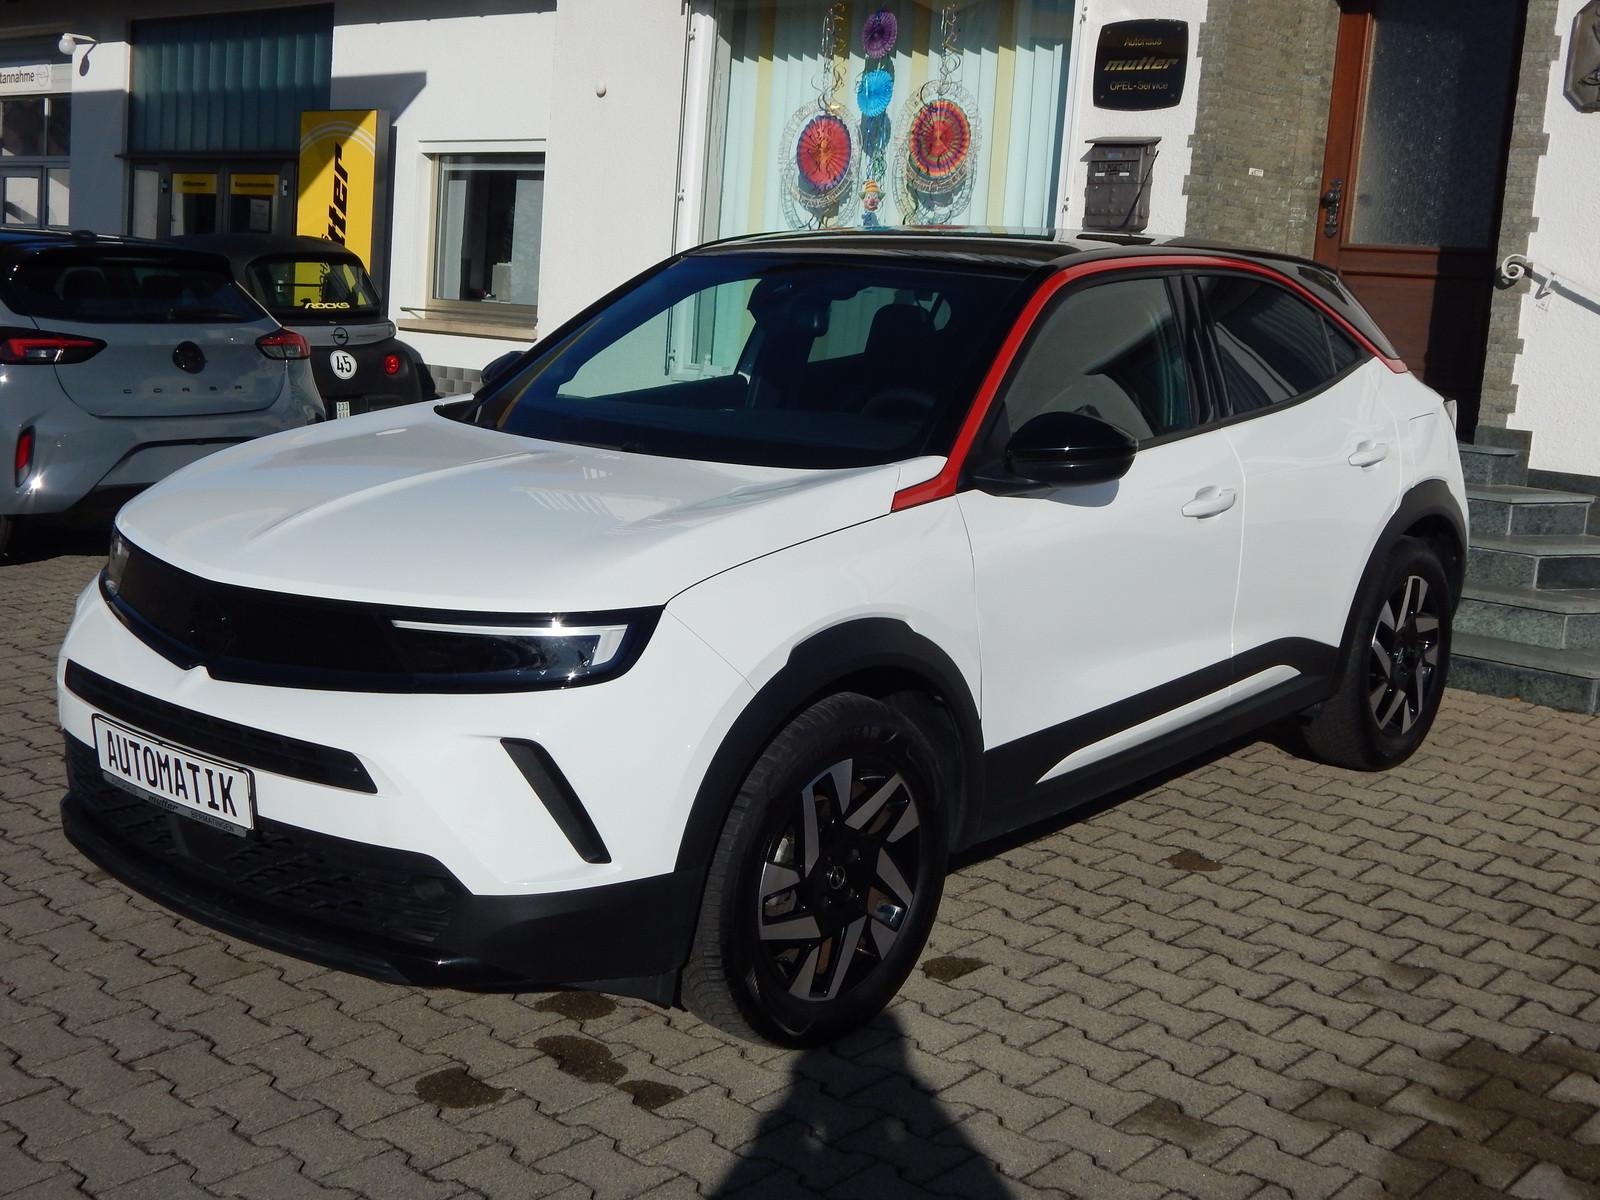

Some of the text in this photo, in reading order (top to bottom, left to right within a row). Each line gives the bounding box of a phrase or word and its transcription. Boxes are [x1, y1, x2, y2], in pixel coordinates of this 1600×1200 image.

[1123, 36, 1162, 47] Autohaus
[1103, 56, 1179, 71] mutter
[1109, 79, 1168, 91] OPEL-Service
[336, 355, 352, 373] 45
[106, 730, 238, 817] AUTOMATIK
